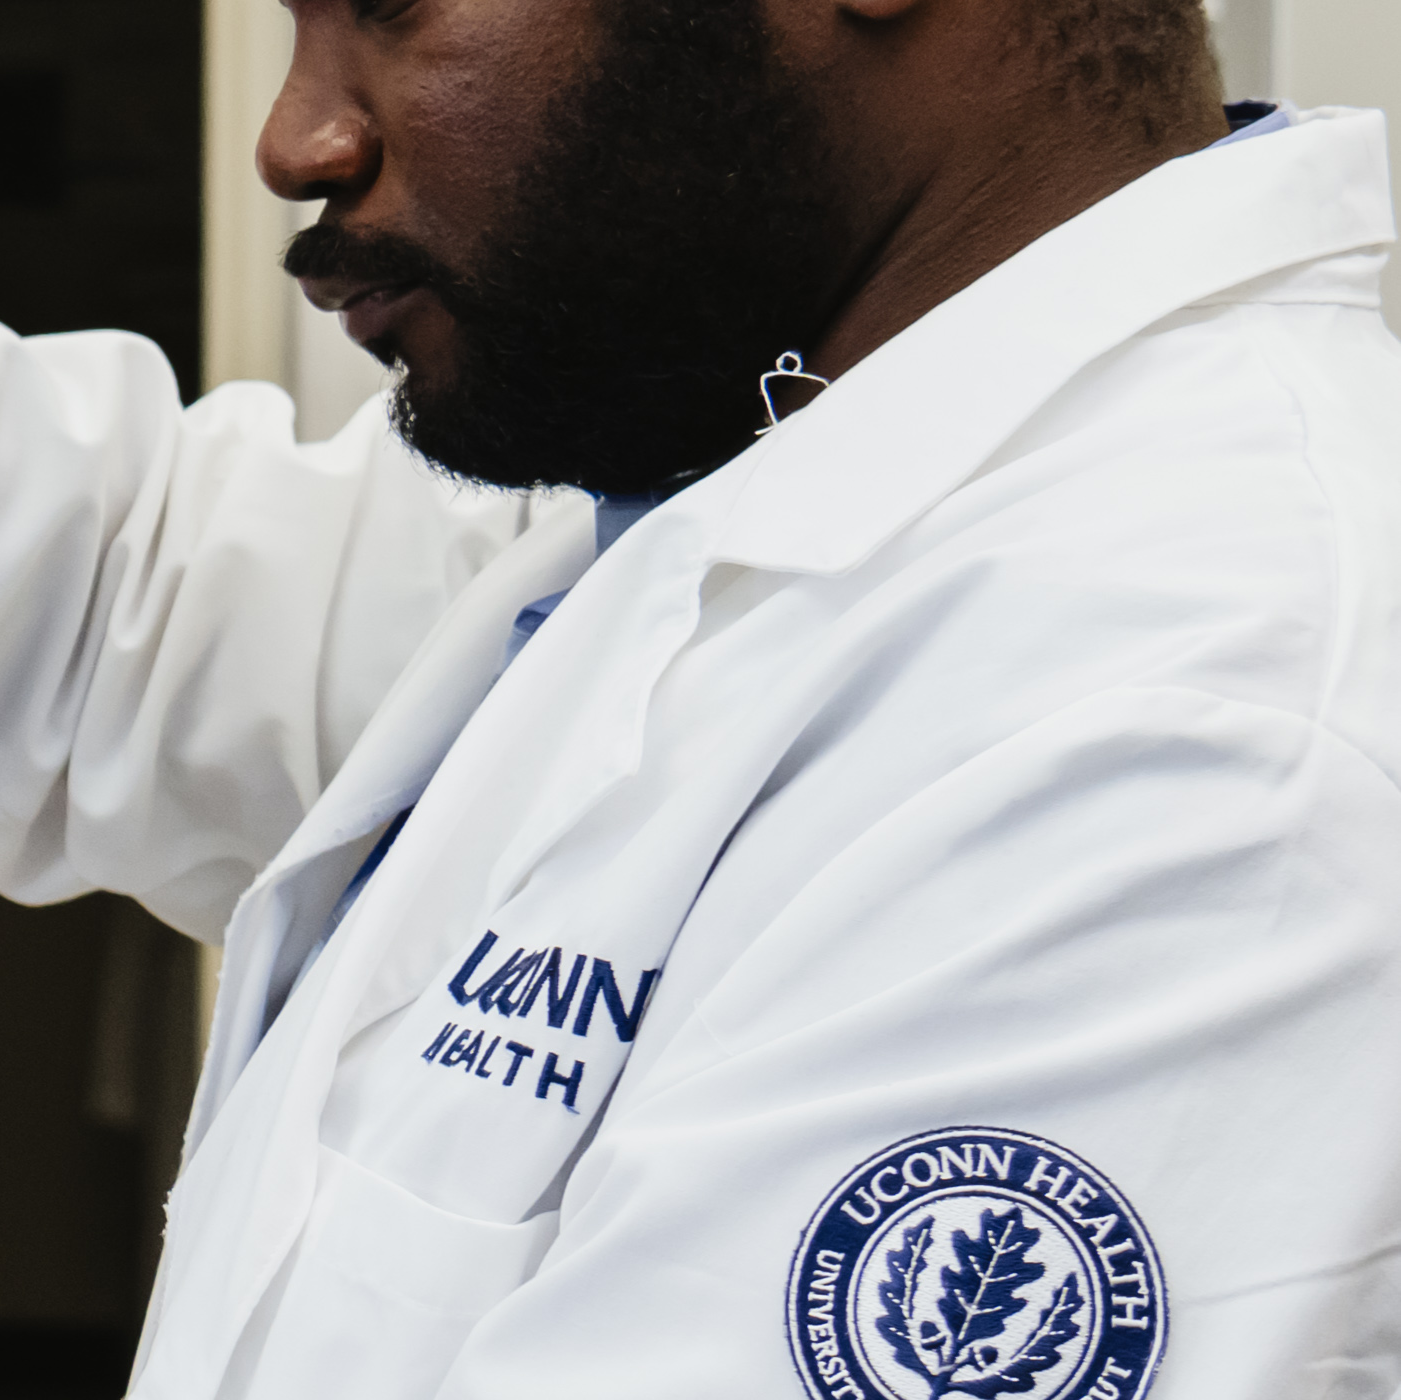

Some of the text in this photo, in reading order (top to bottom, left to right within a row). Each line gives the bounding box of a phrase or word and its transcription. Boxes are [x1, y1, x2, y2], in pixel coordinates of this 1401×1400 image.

[421, 1022, 585, 1111] HEALTH
[840, 1142, 1150, 1331] UCONN HEALTH
